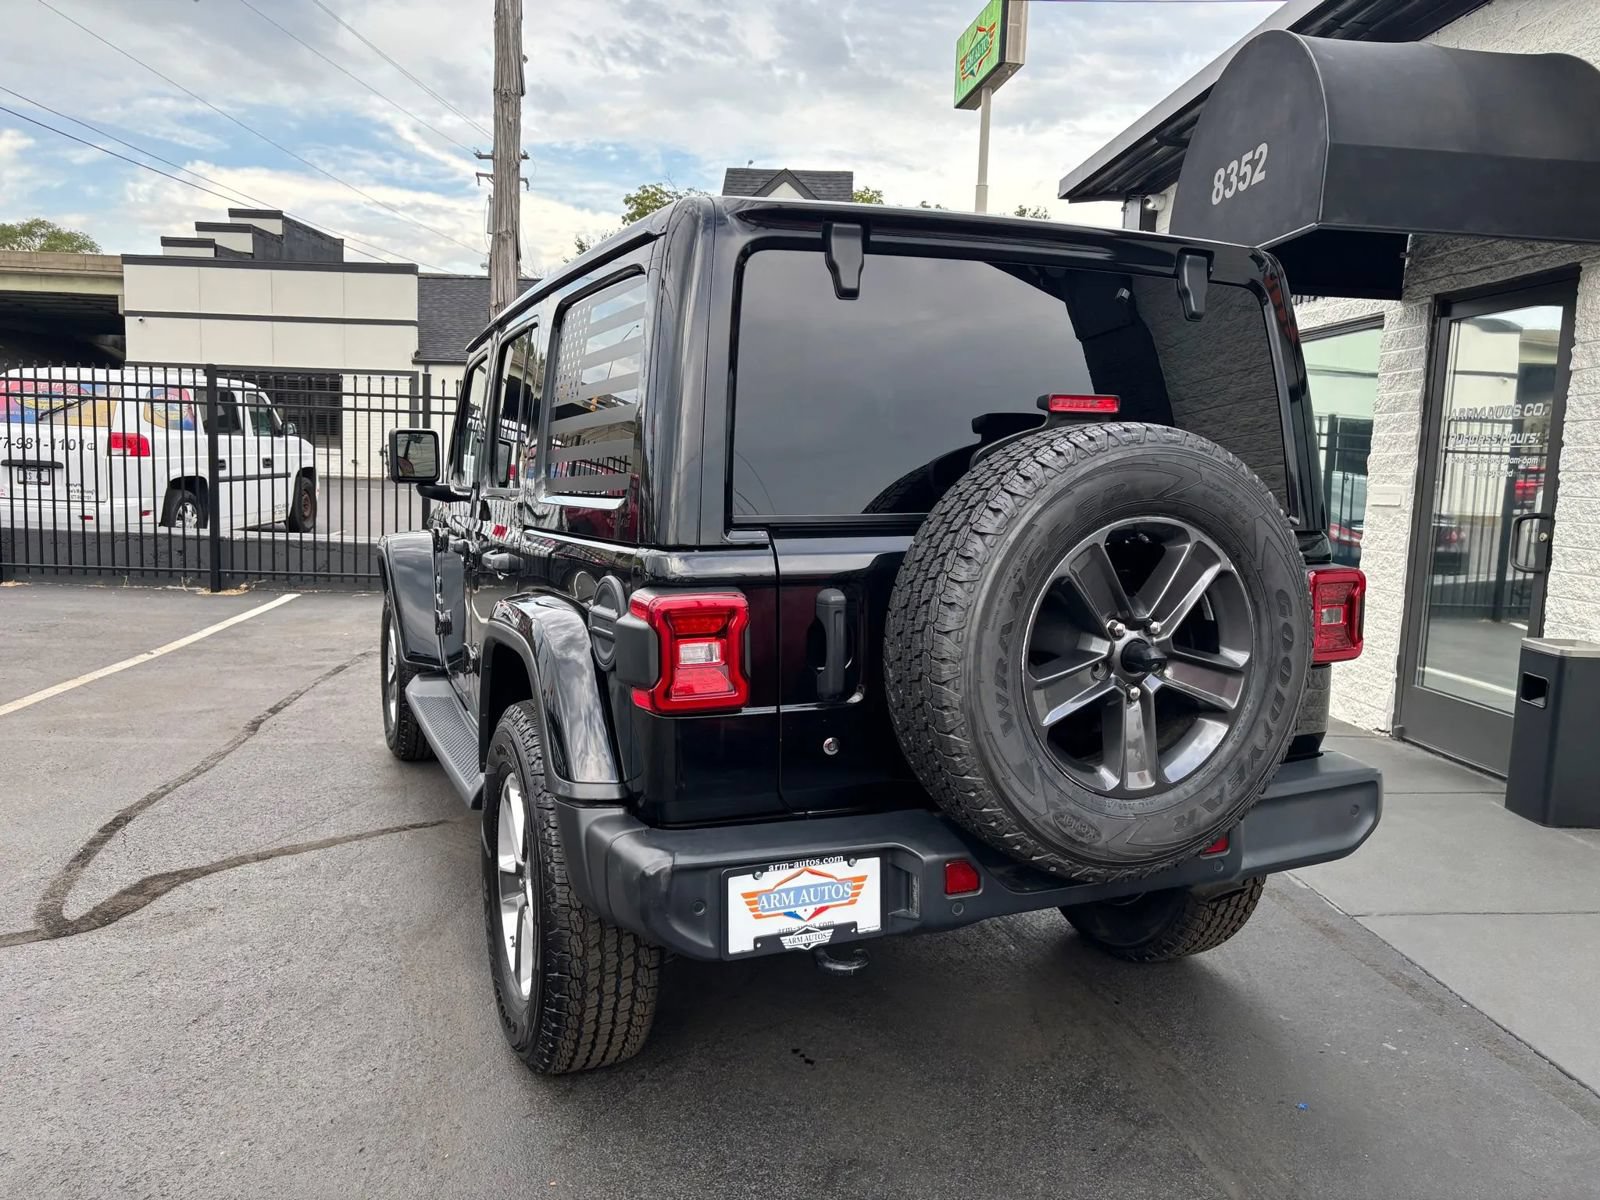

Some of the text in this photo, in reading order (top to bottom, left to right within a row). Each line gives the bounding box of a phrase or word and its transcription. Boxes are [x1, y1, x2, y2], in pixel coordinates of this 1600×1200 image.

[1212, 142, 1268, 205] 8352
[768, 855, 844, 872] arm-autos.com
[759, 881, 852, 910] ARM AUTOS
[788, 932, 827, 944] ARM AUTOS
